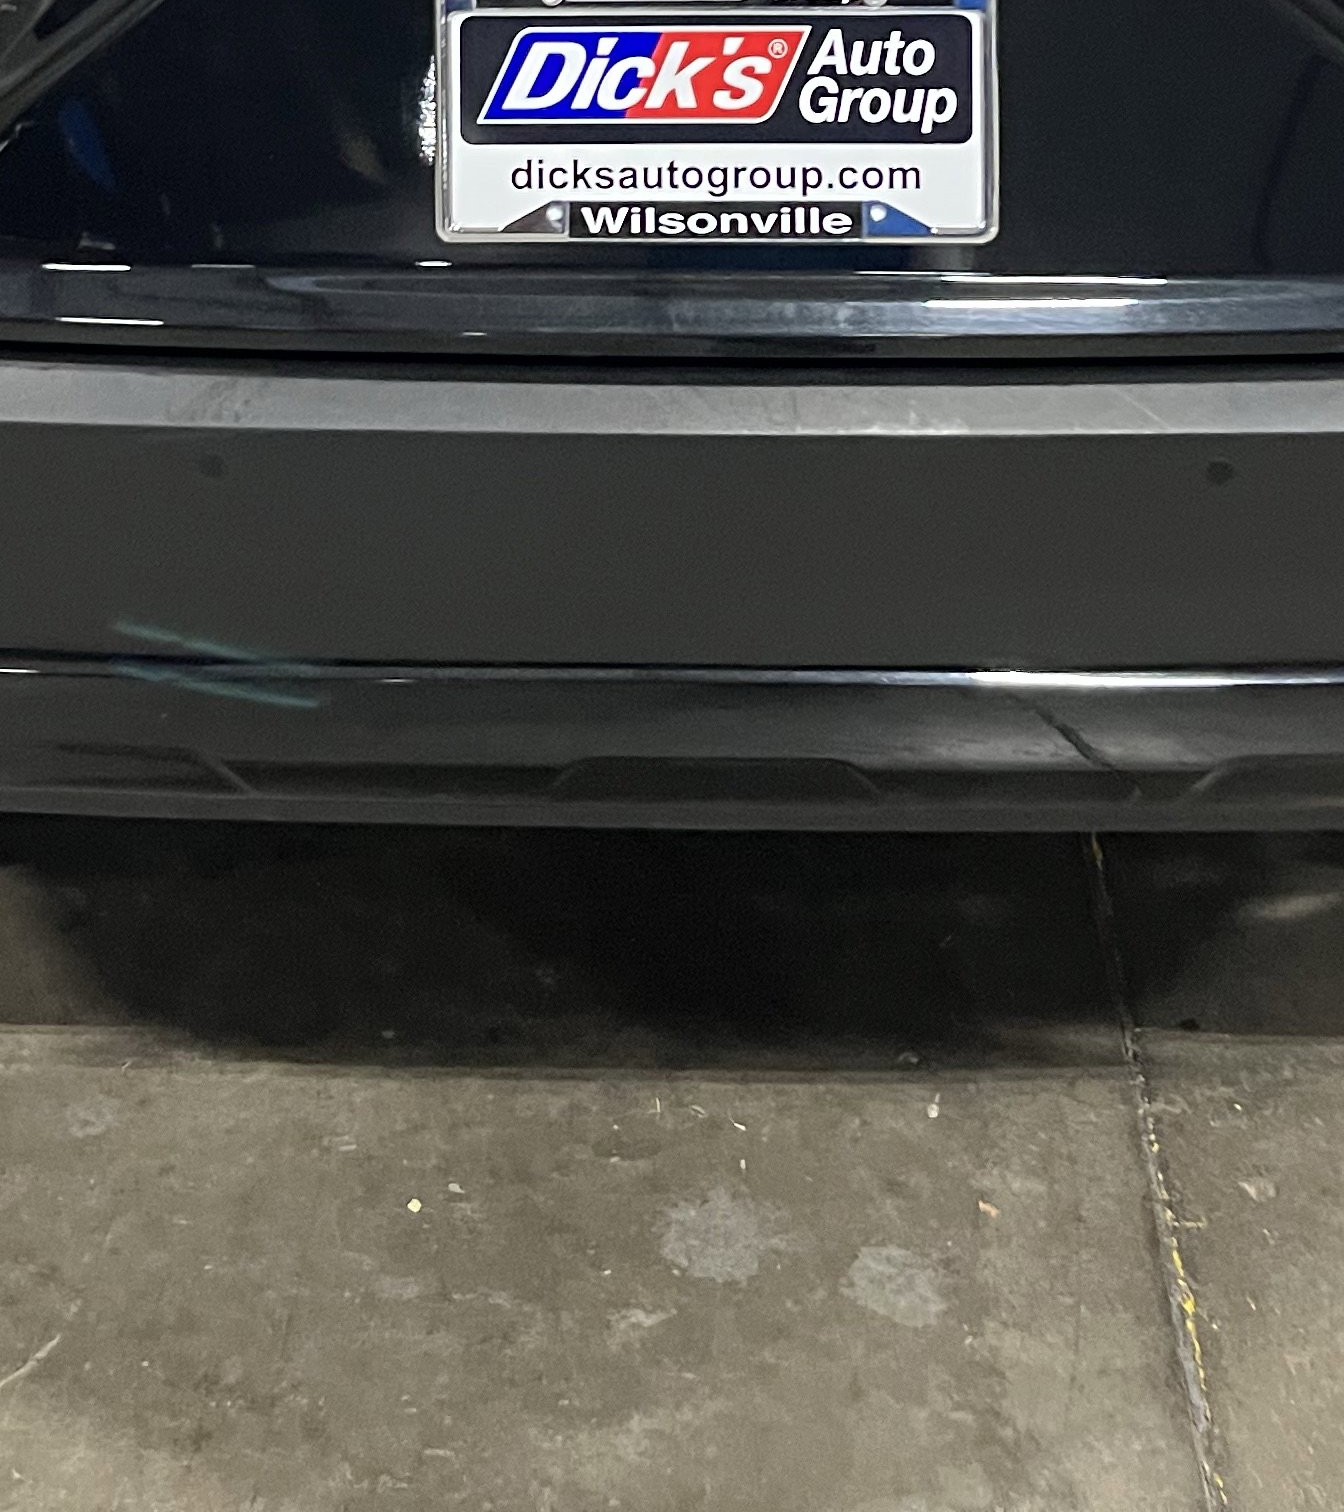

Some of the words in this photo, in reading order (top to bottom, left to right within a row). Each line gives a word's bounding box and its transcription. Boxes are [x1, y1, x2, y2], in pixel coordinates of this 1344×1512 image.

[807, 28, 935, 76] Auto
[798, 76, 957, 134] Group
[511, 159, 921, 196] dicksautogroup.com
[581, 206, 853, 236] Wilsonville
